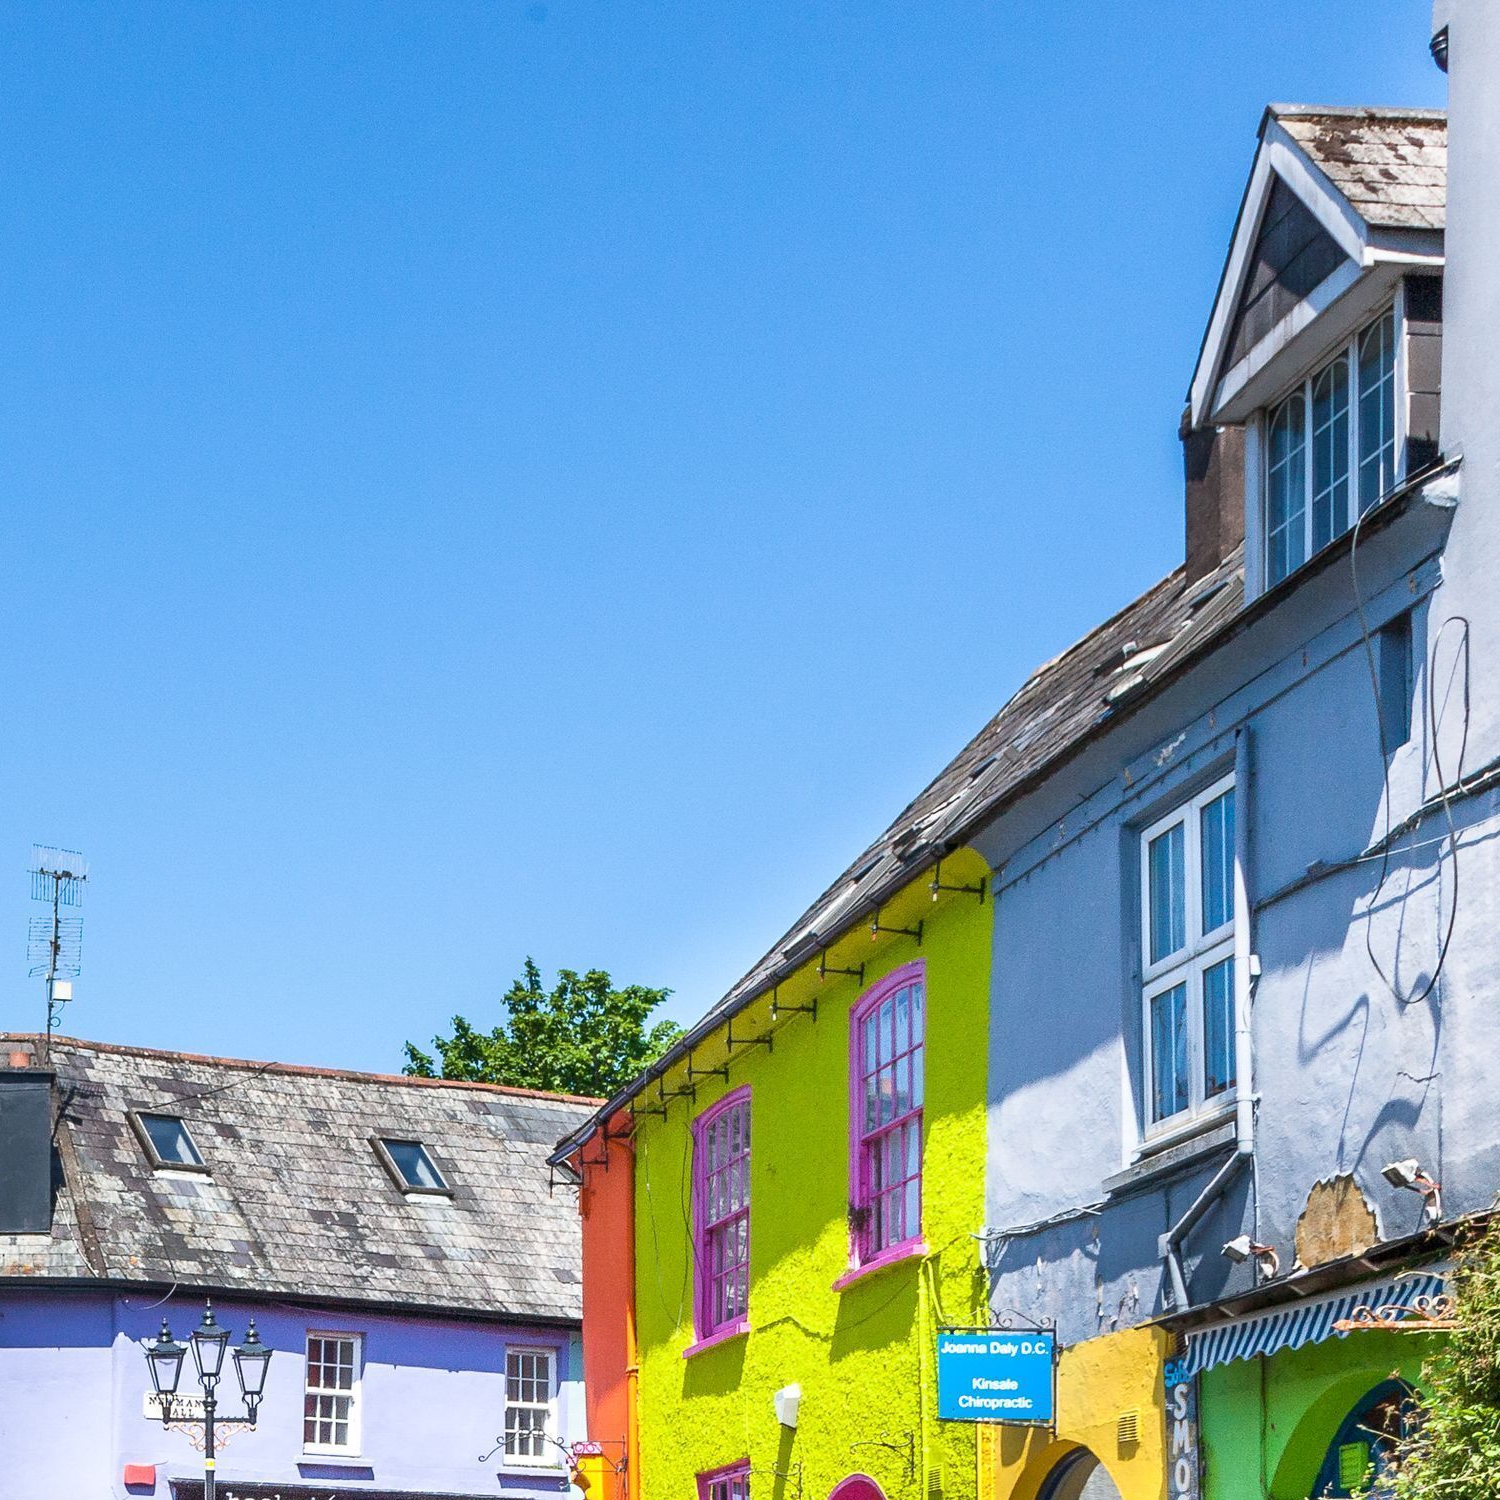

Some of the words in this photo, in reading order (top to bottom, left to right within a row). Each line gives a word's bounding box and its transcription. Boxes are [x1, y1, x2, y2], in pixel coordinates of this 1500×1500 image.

[940, 1341, 988, 1354] Joanna
[989, 1341, 1019, 1357] Daly
[1021, 1342, 1050, 1355] D.C.
[971, 1377, 1019, 1391] Kinsale
[958, 1395, 1034, 1411] Chiropractic
